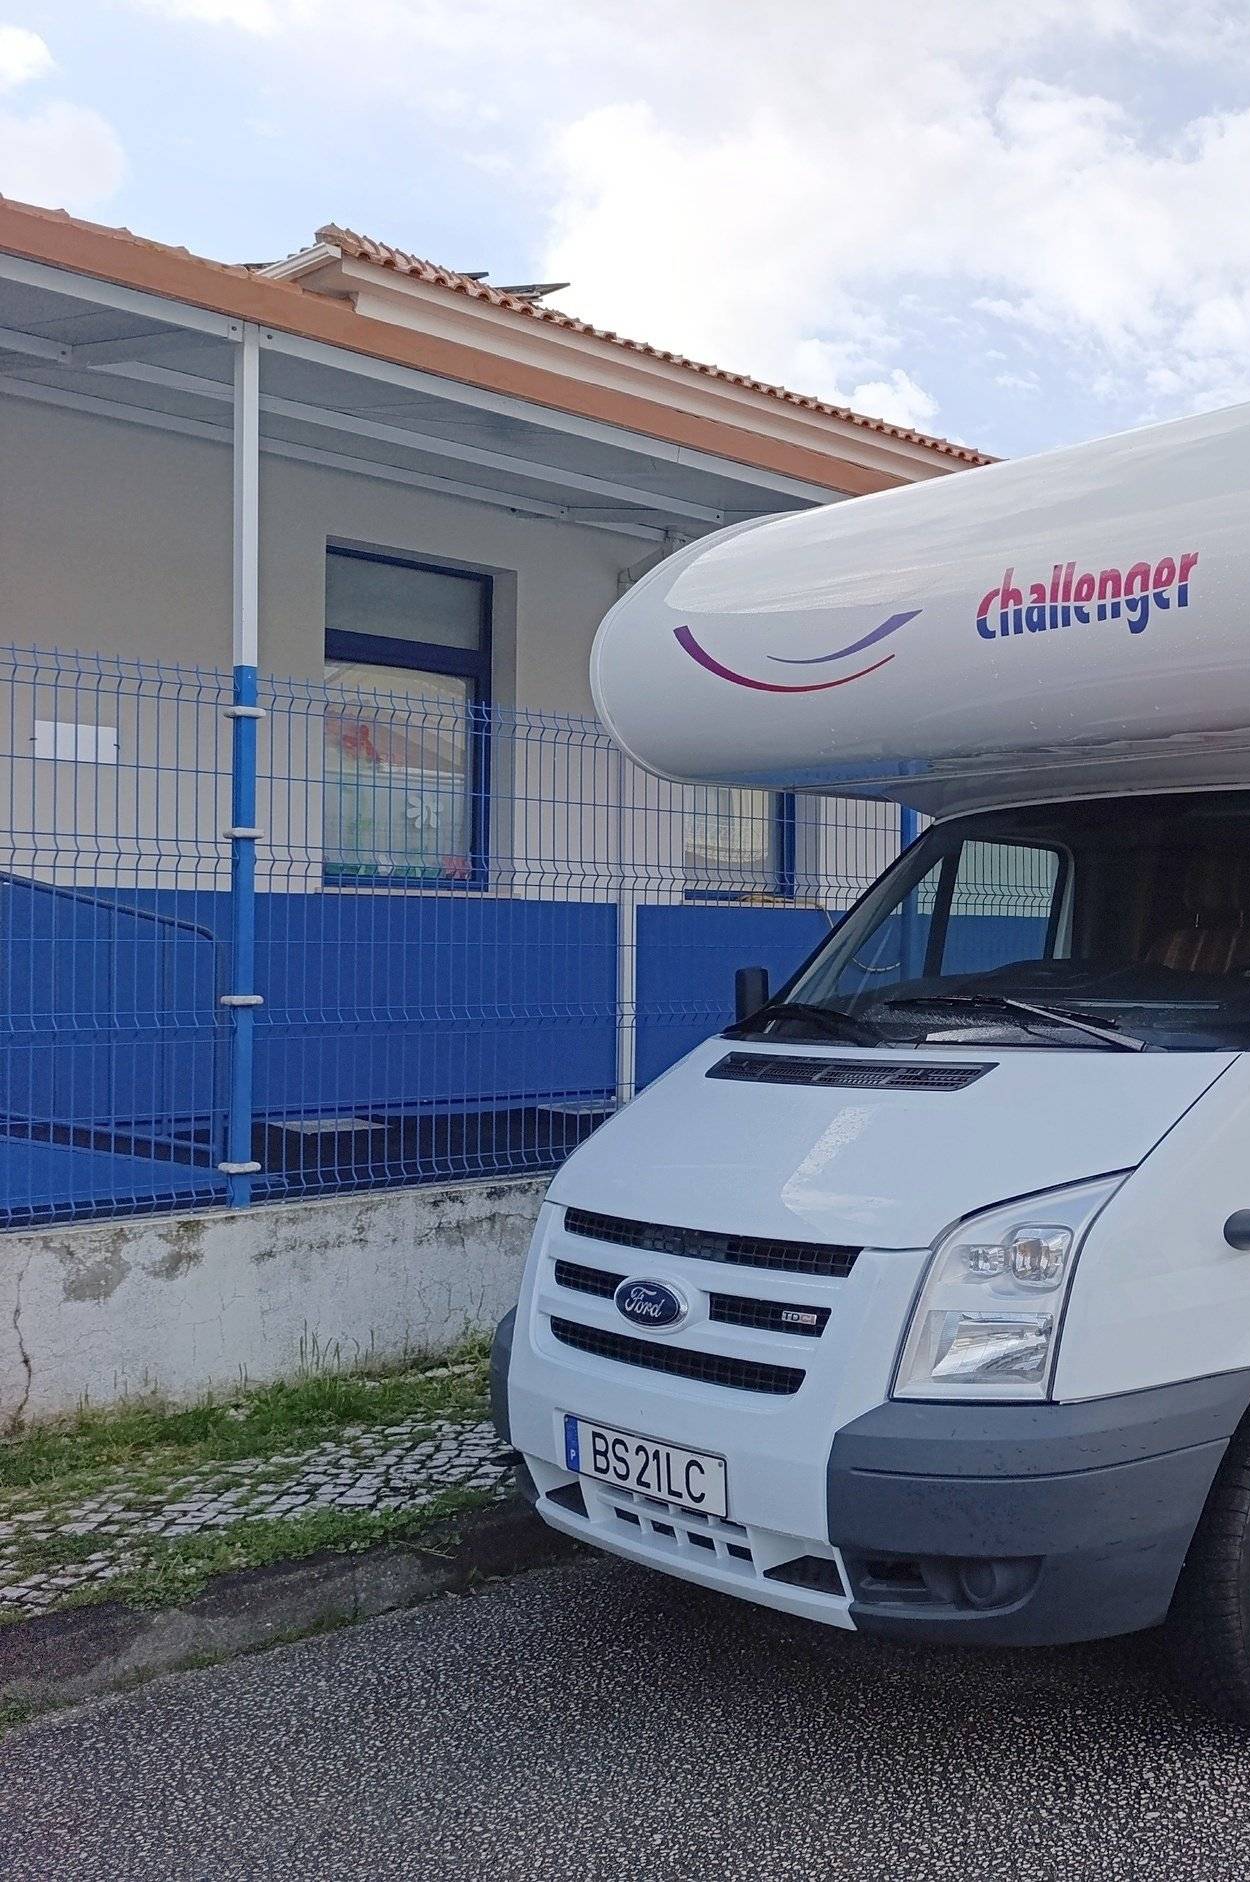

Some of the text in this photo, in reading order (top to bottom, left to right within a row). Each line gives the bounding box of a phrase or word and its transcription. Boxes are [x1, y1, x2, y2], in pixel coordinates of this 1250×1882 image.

[976, 552, 1199, 640] challenger
[625, 1286, 665, 1317] Ford
[570, 1450, 576, 1460] P
